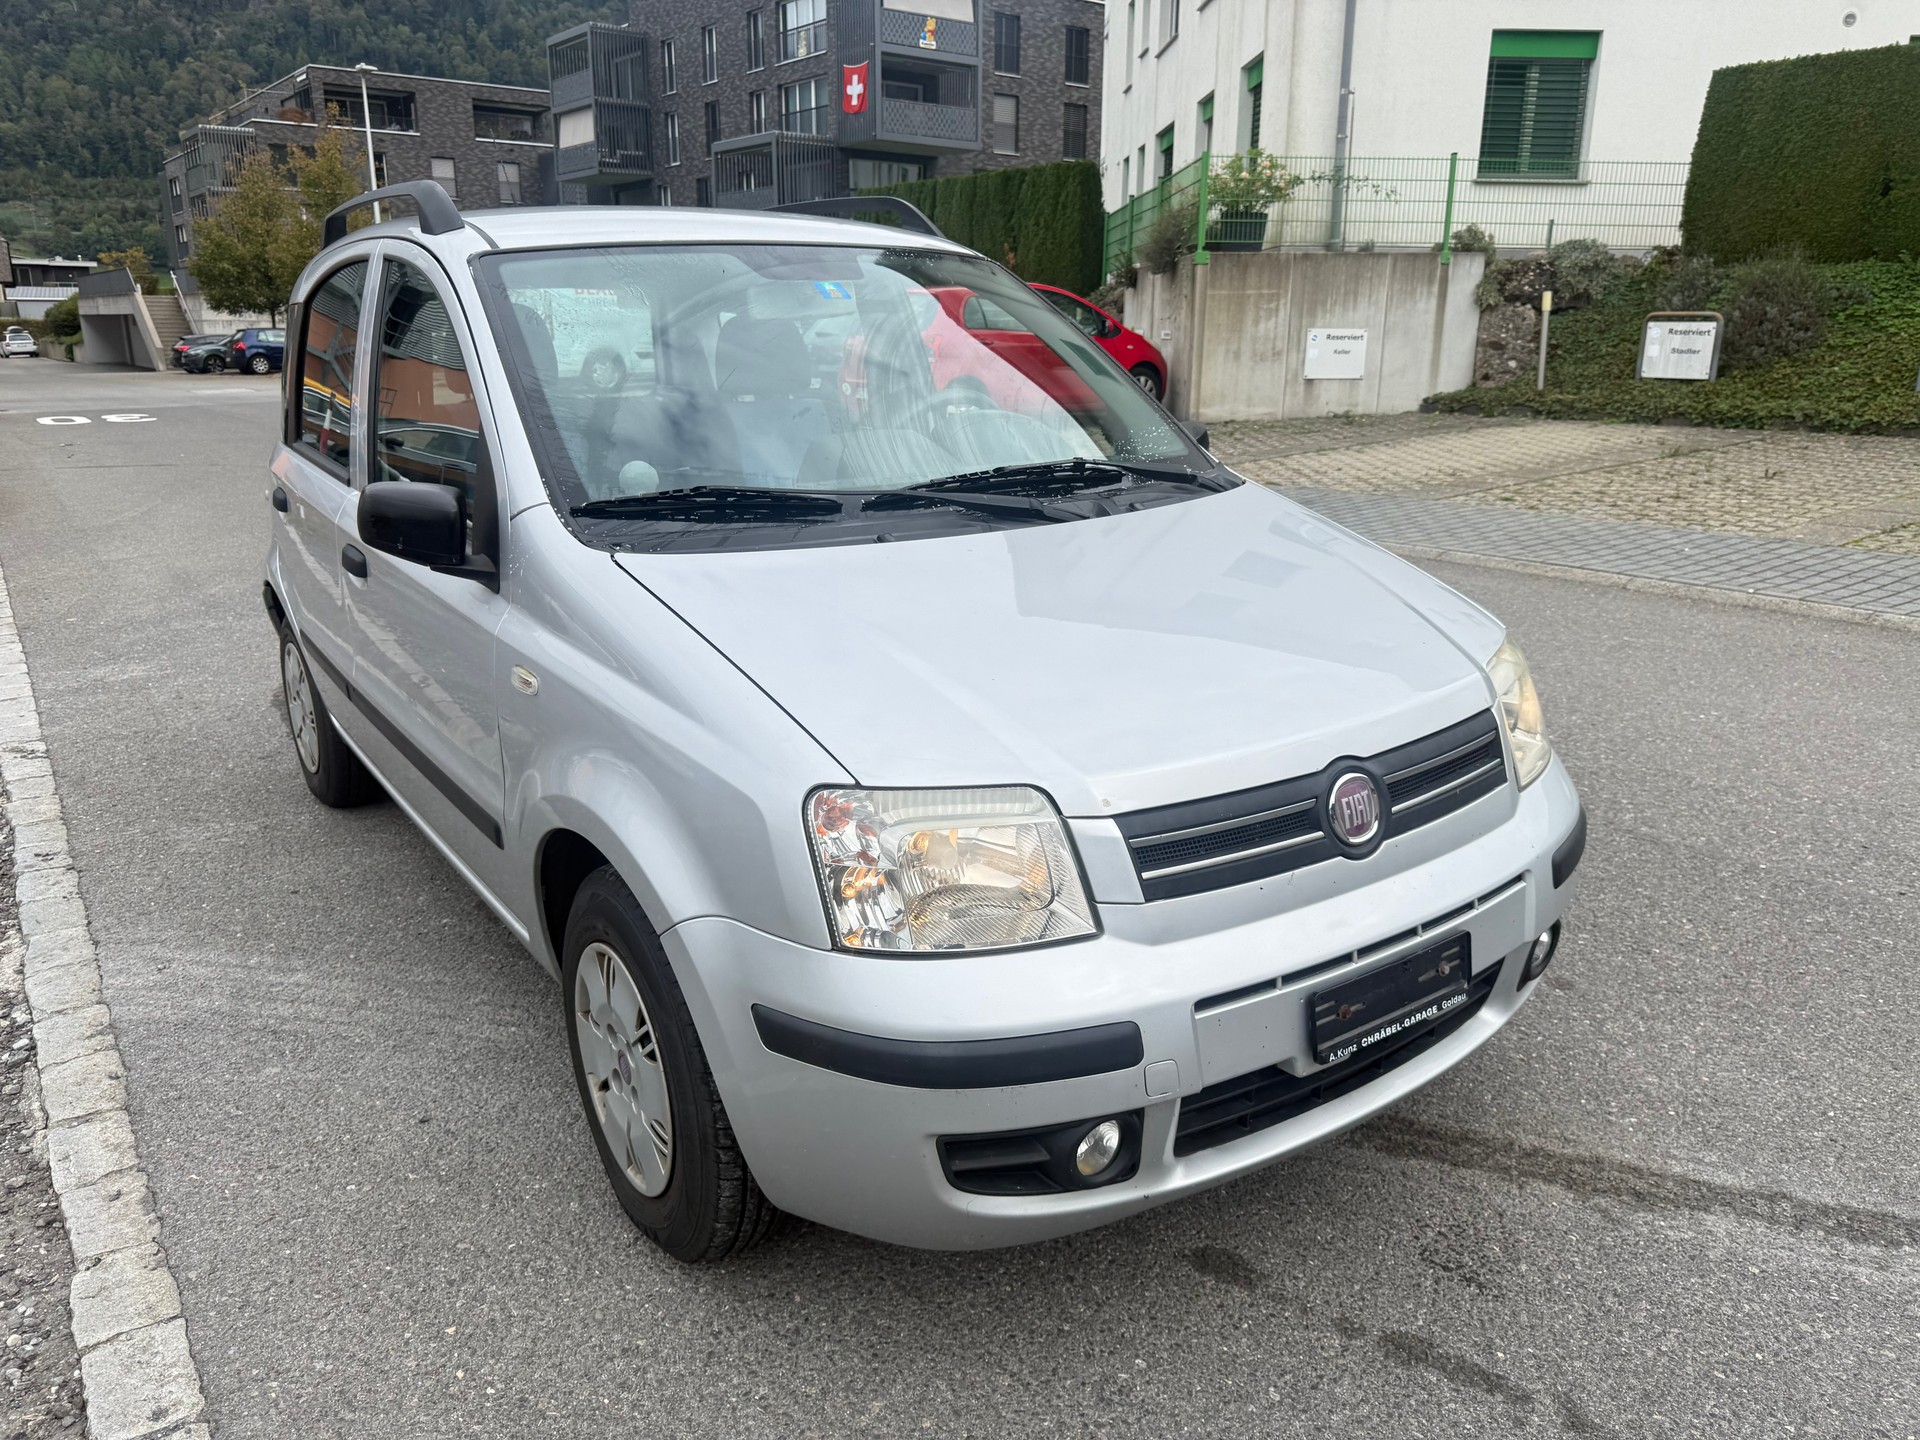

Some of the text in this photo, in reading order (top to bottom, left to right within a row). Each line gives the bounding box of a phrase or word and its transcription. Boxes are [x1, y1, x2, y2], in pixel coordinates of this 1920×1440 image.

[1668, 327, 1712, 336] Reserviert
[1671, 347, 1701, 355] Stadler
[1341, 789, 1370, 829] FIAT
[1329, 993, 1466, 1062] A.Kunz CHRÄBEL-GARAGE Goldau
